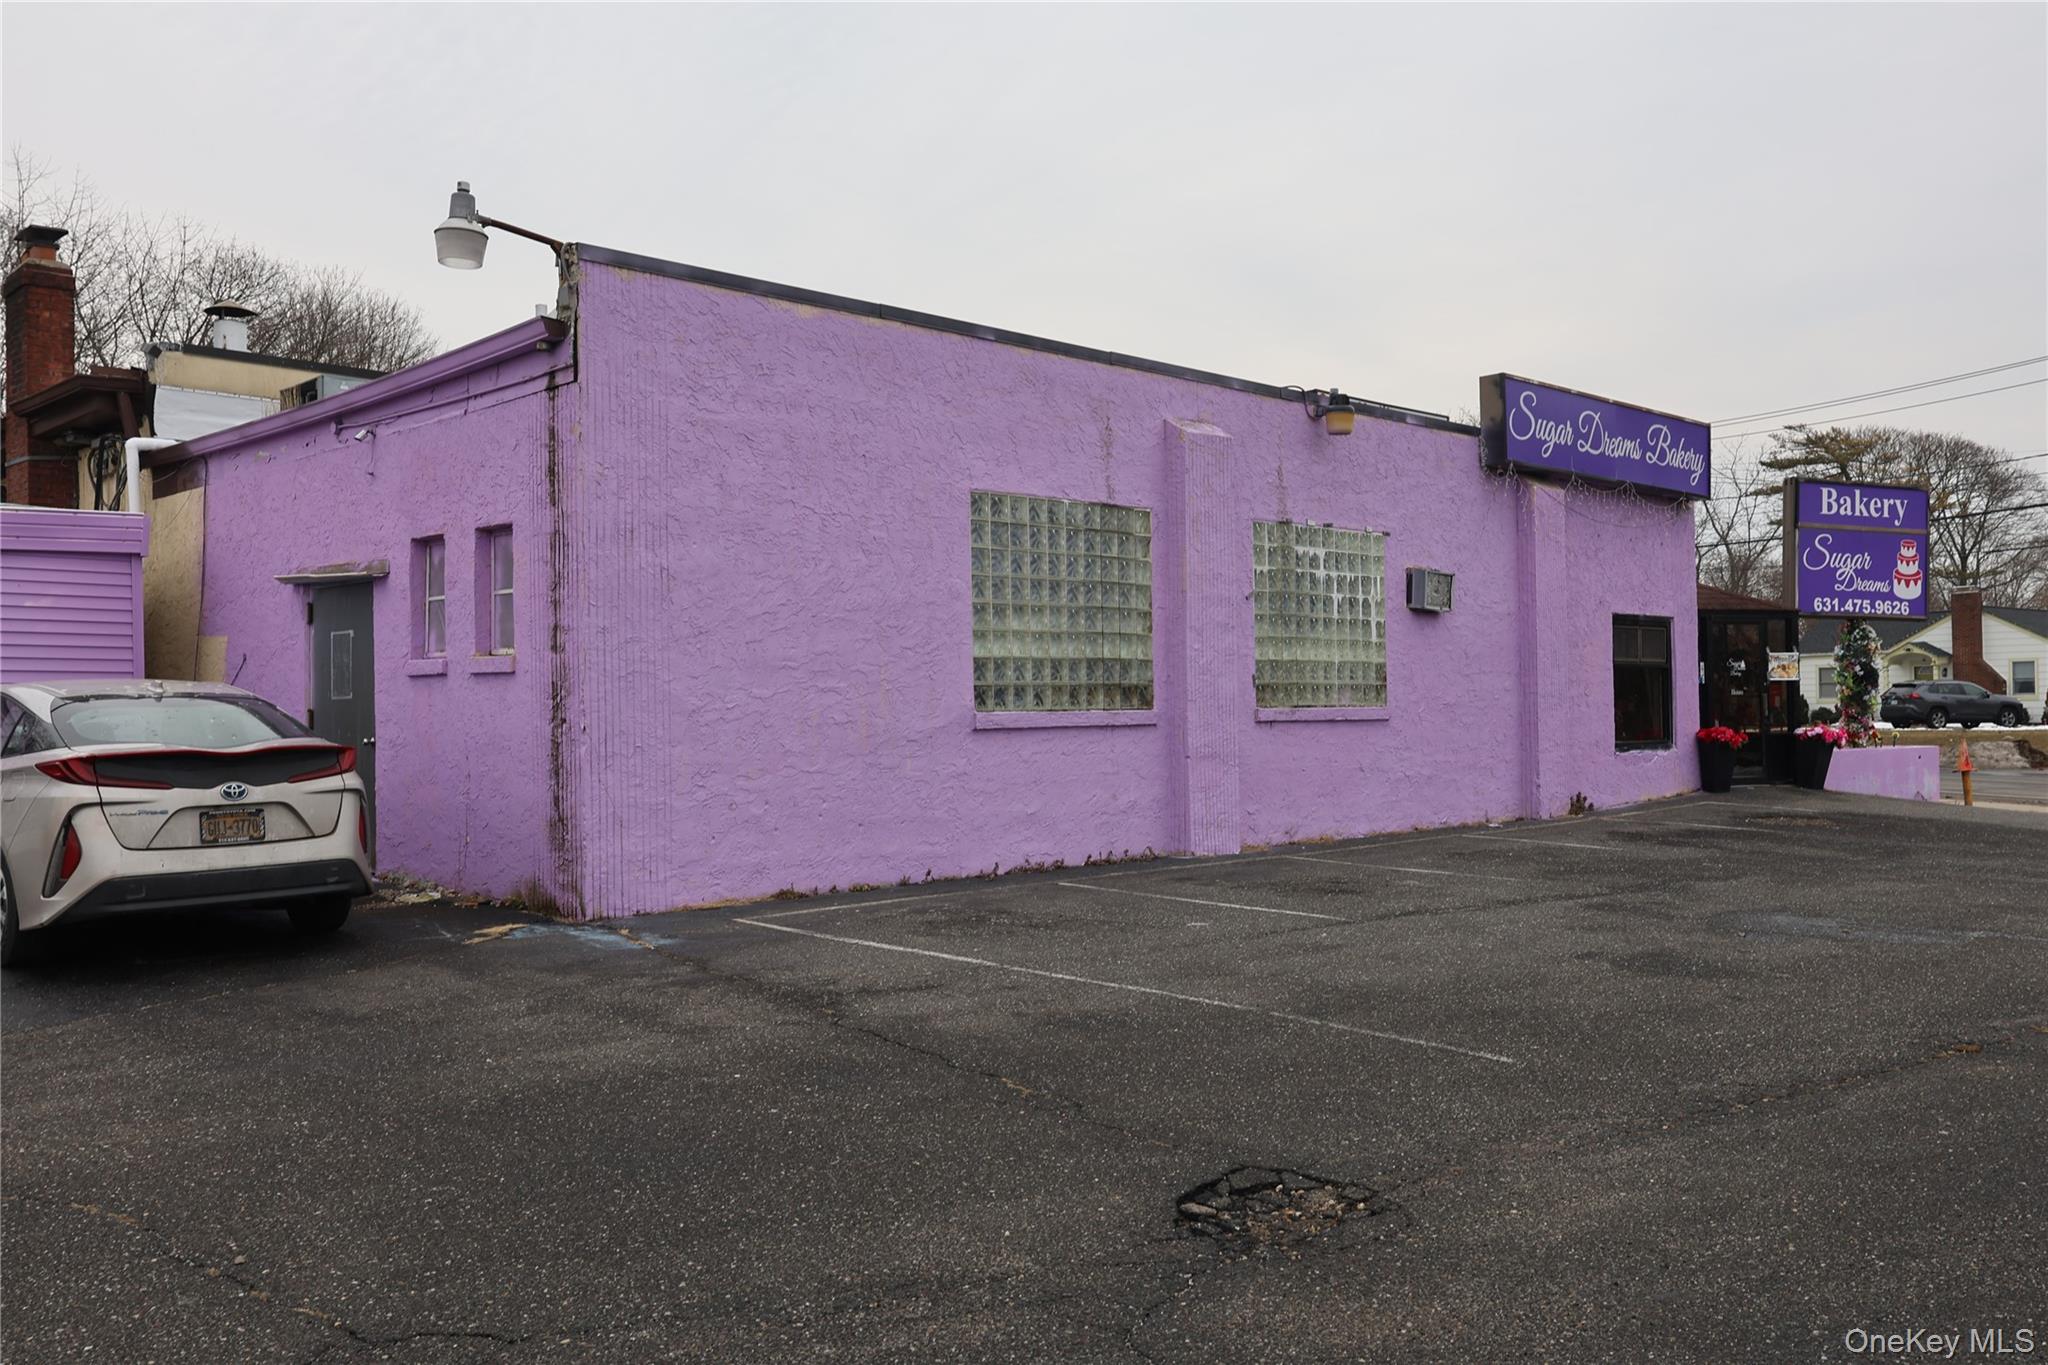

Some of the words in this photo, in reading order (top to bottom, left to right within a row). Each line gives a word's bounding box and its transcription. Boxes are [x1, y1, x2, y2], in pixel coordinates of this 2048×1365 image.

[1509, 391, 1574, 458] Sugar
[1577, 410, 1643, 460] Dreams
[1646, 424, 1705, 486] Bakery
[1820, 487, 1908, 526] Bakery
[1803, 533, 1872, 581] Sugar
[1834, 568, 1891, 593] Dreams
[1814, 597, 1910, 615] 631.475.9626
